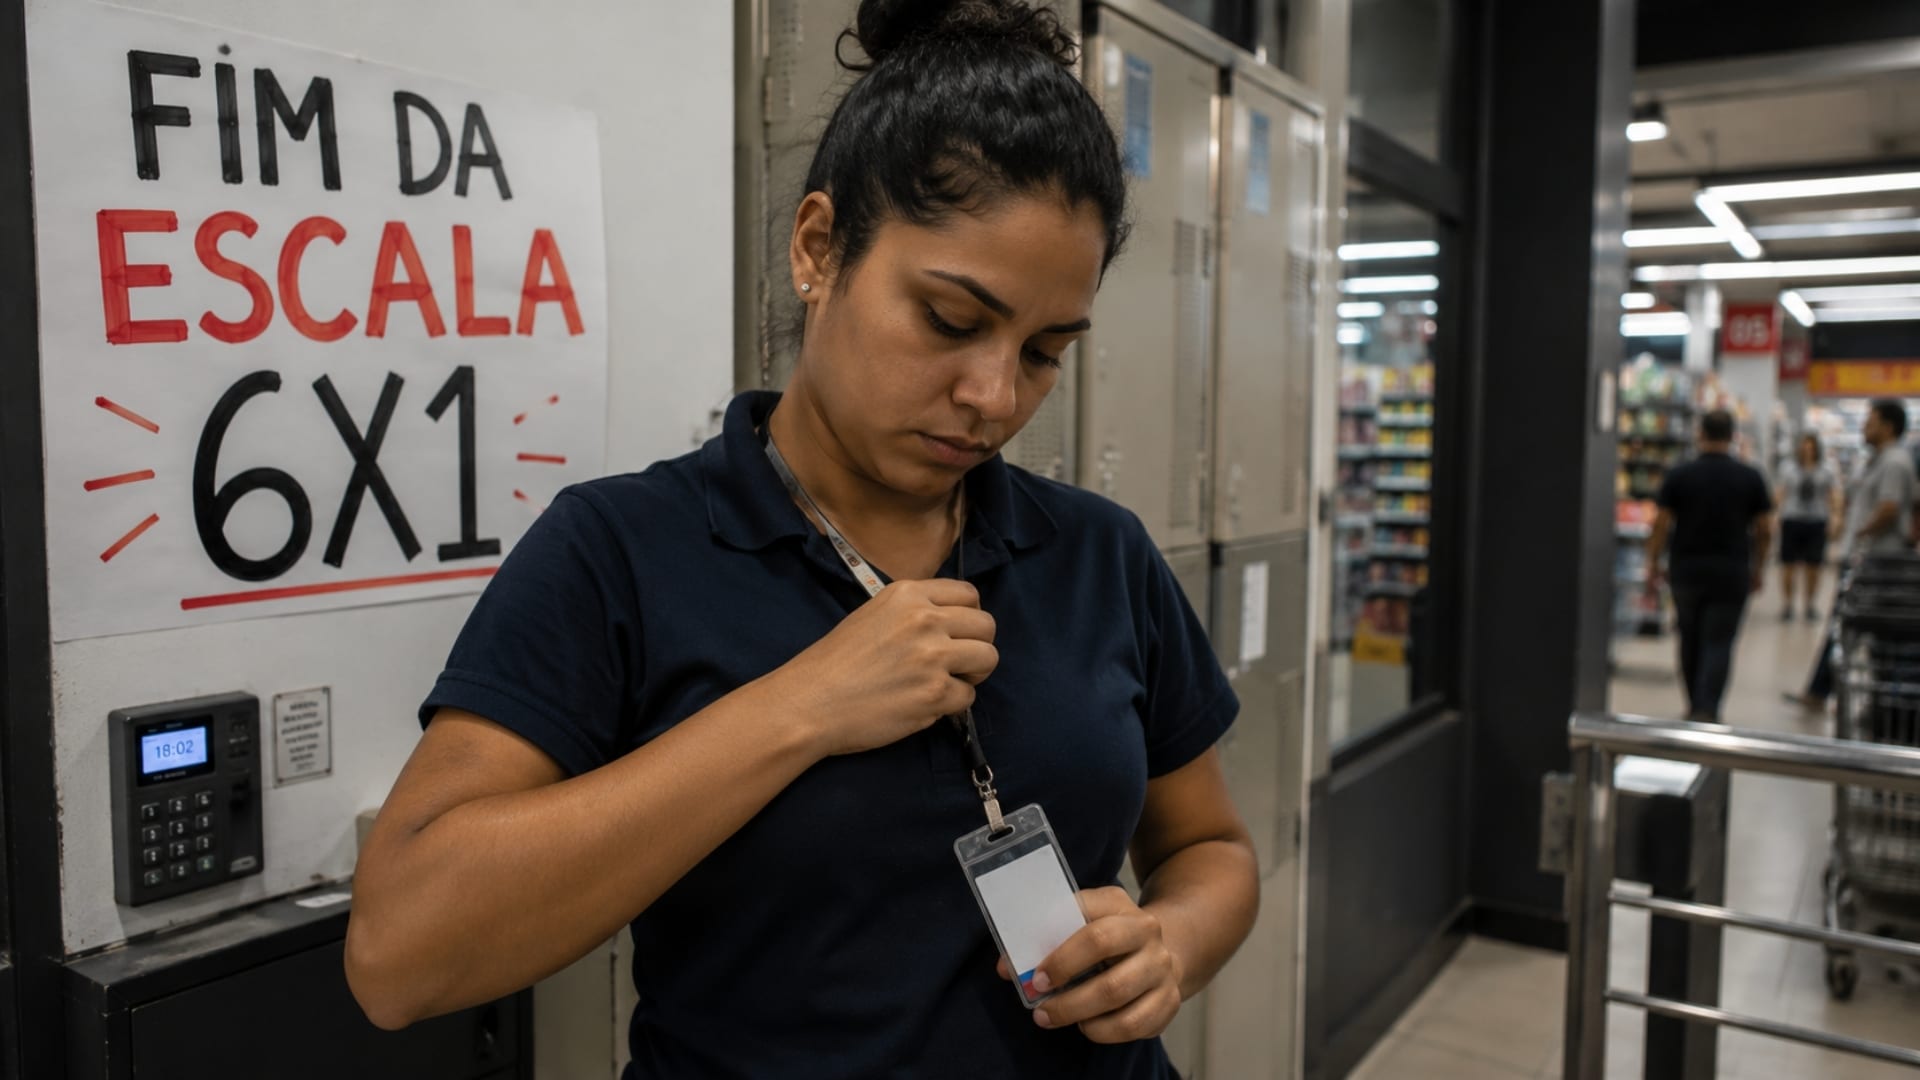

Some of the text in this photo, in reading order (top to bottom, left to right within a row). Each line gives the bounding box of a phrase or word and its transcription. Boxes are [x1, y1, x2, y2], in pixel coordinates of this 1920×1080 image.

[127, 48, 512, 200] FIM DA
[97, 209, 584, 344] ESCALA
[193, 366, 500, 582] 6X1
[155, 740, 194, 759] 18:02
